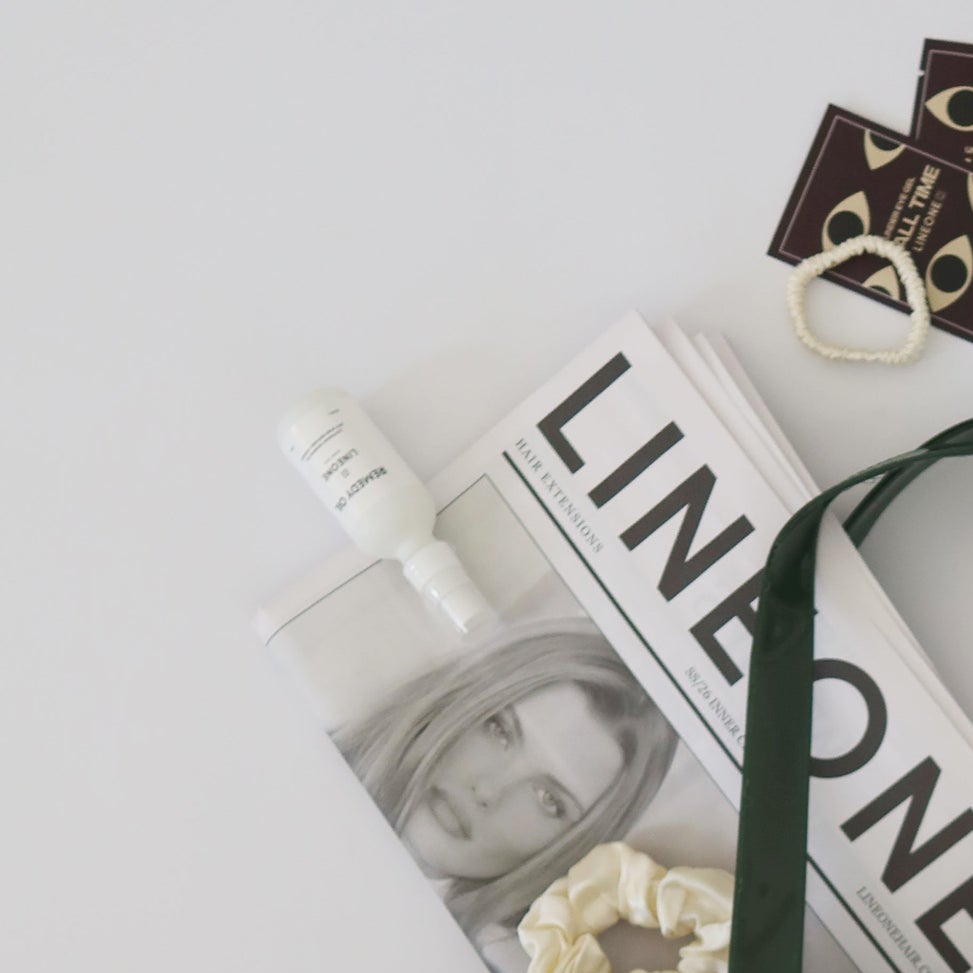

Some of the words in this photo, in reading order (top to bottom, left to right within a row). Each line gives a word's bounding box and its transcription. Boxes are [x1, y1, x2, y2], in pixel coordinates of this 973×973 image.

[908, 165, 941, 210] TIME
[913, 201, 942, 253] LINEONE
[346, 466, 388, 499] REMEDY
[514, 437, 542, 472] HAIR
[540, 473, 604, 553] EXTENSIONS
[708, 697, 741, 737] INNER
